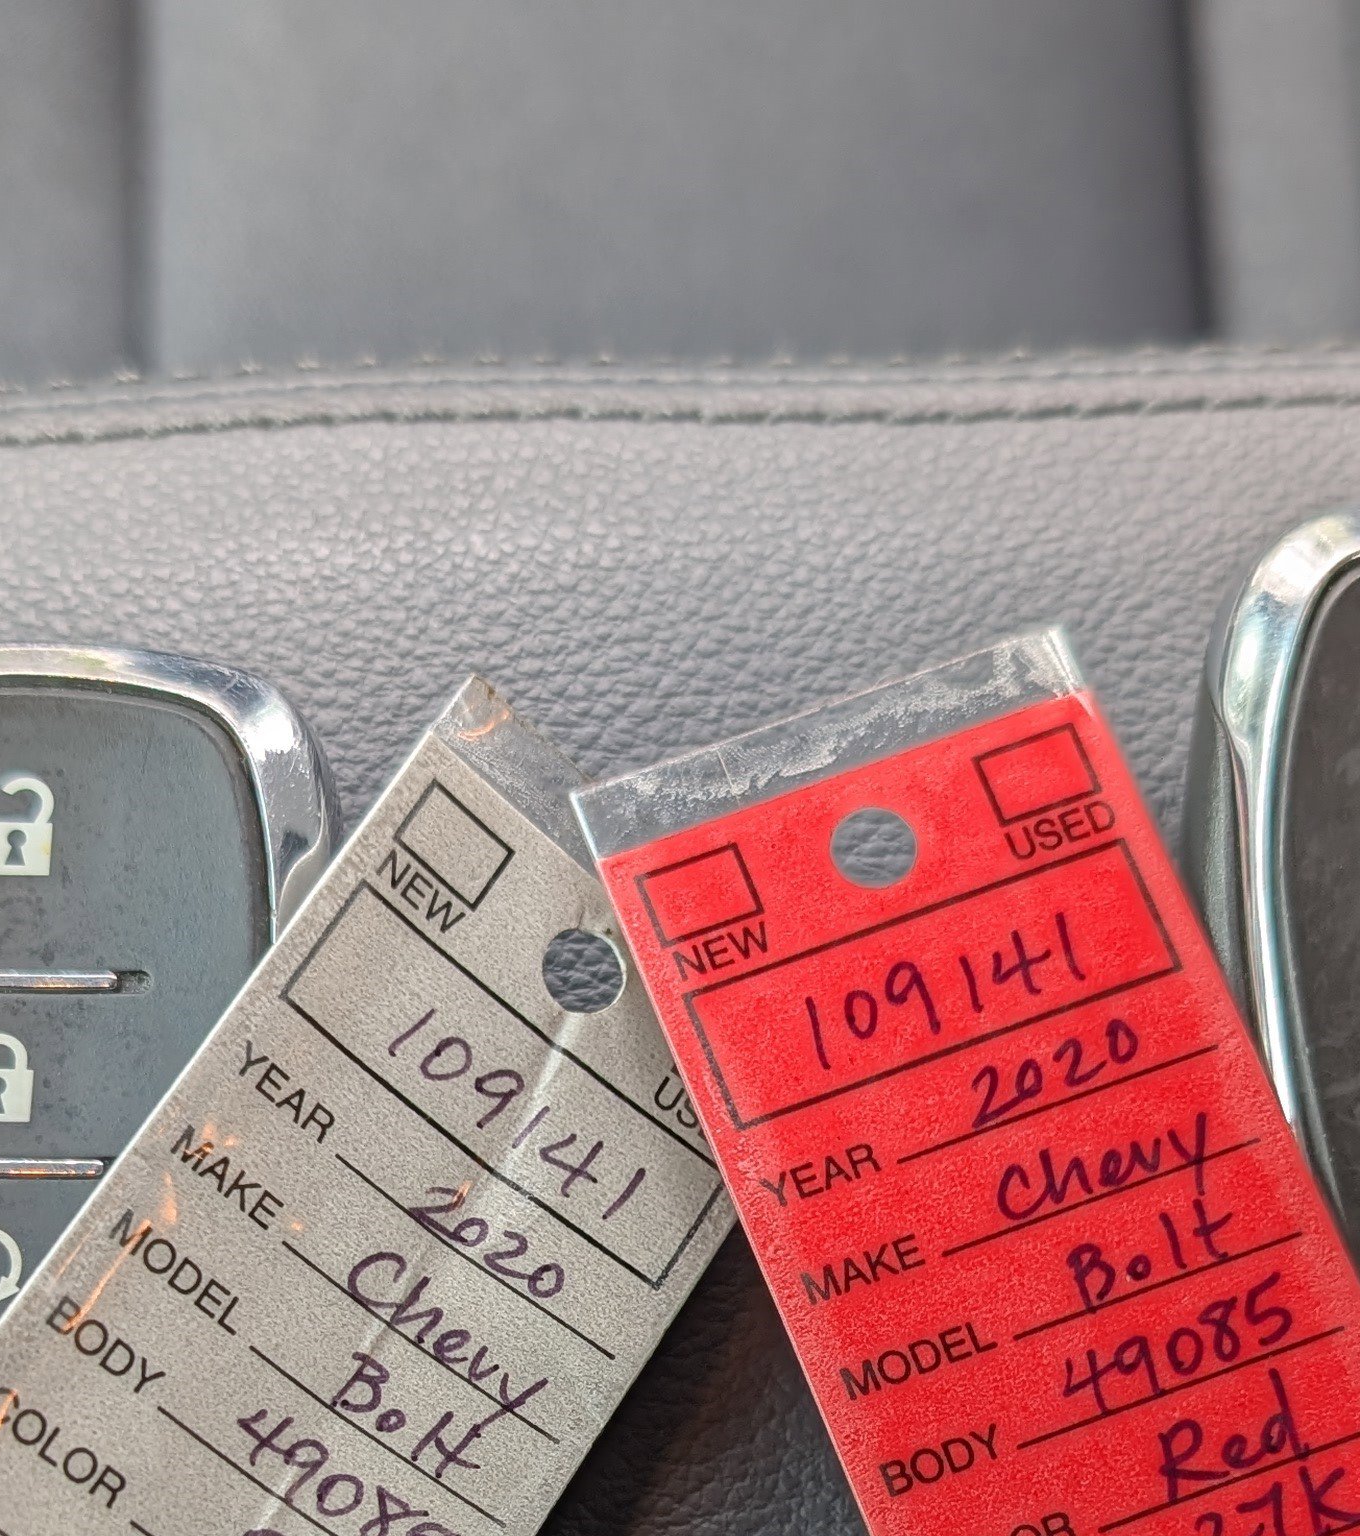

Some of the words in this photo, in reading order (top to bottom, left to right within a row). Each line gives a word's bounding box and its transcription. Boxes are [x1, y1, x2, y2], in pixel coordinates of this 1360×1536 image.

[1005, 800, 1117, 861] USED
[376, 849, 466, 934] NEW
[671, 921, 770, 981] NEW
[805, 911, 1087, 1072] 109141
[238, 1039, 337, 1145] YEAR
[388, 1007, 648, 1221] 109141
[653, 1075, 706, 1140] US
[970, 1018, 1141, 1130] 2020
[170, 1124, 285, 1231] MAKE
[758, 1142, 883, 1208] YEAR
[109, 1207, 240, 1337] MODEL
[409, 1185, 566, 1300] 2020
[800, 1233, 927, 1306] MAKE
[1065, 1198, 1235, 1314] Bolt
[44, 1296, 167, 1394] BODY
[346, 1251, 550, 1430] Chevy
[839, 1321, 998, 1402] MODEL
[1061, 1270, 1295, 1417] 49085
[877, 1422, 1004, 1500] BODY
[1156, 1368, 1309, 1502] Red
